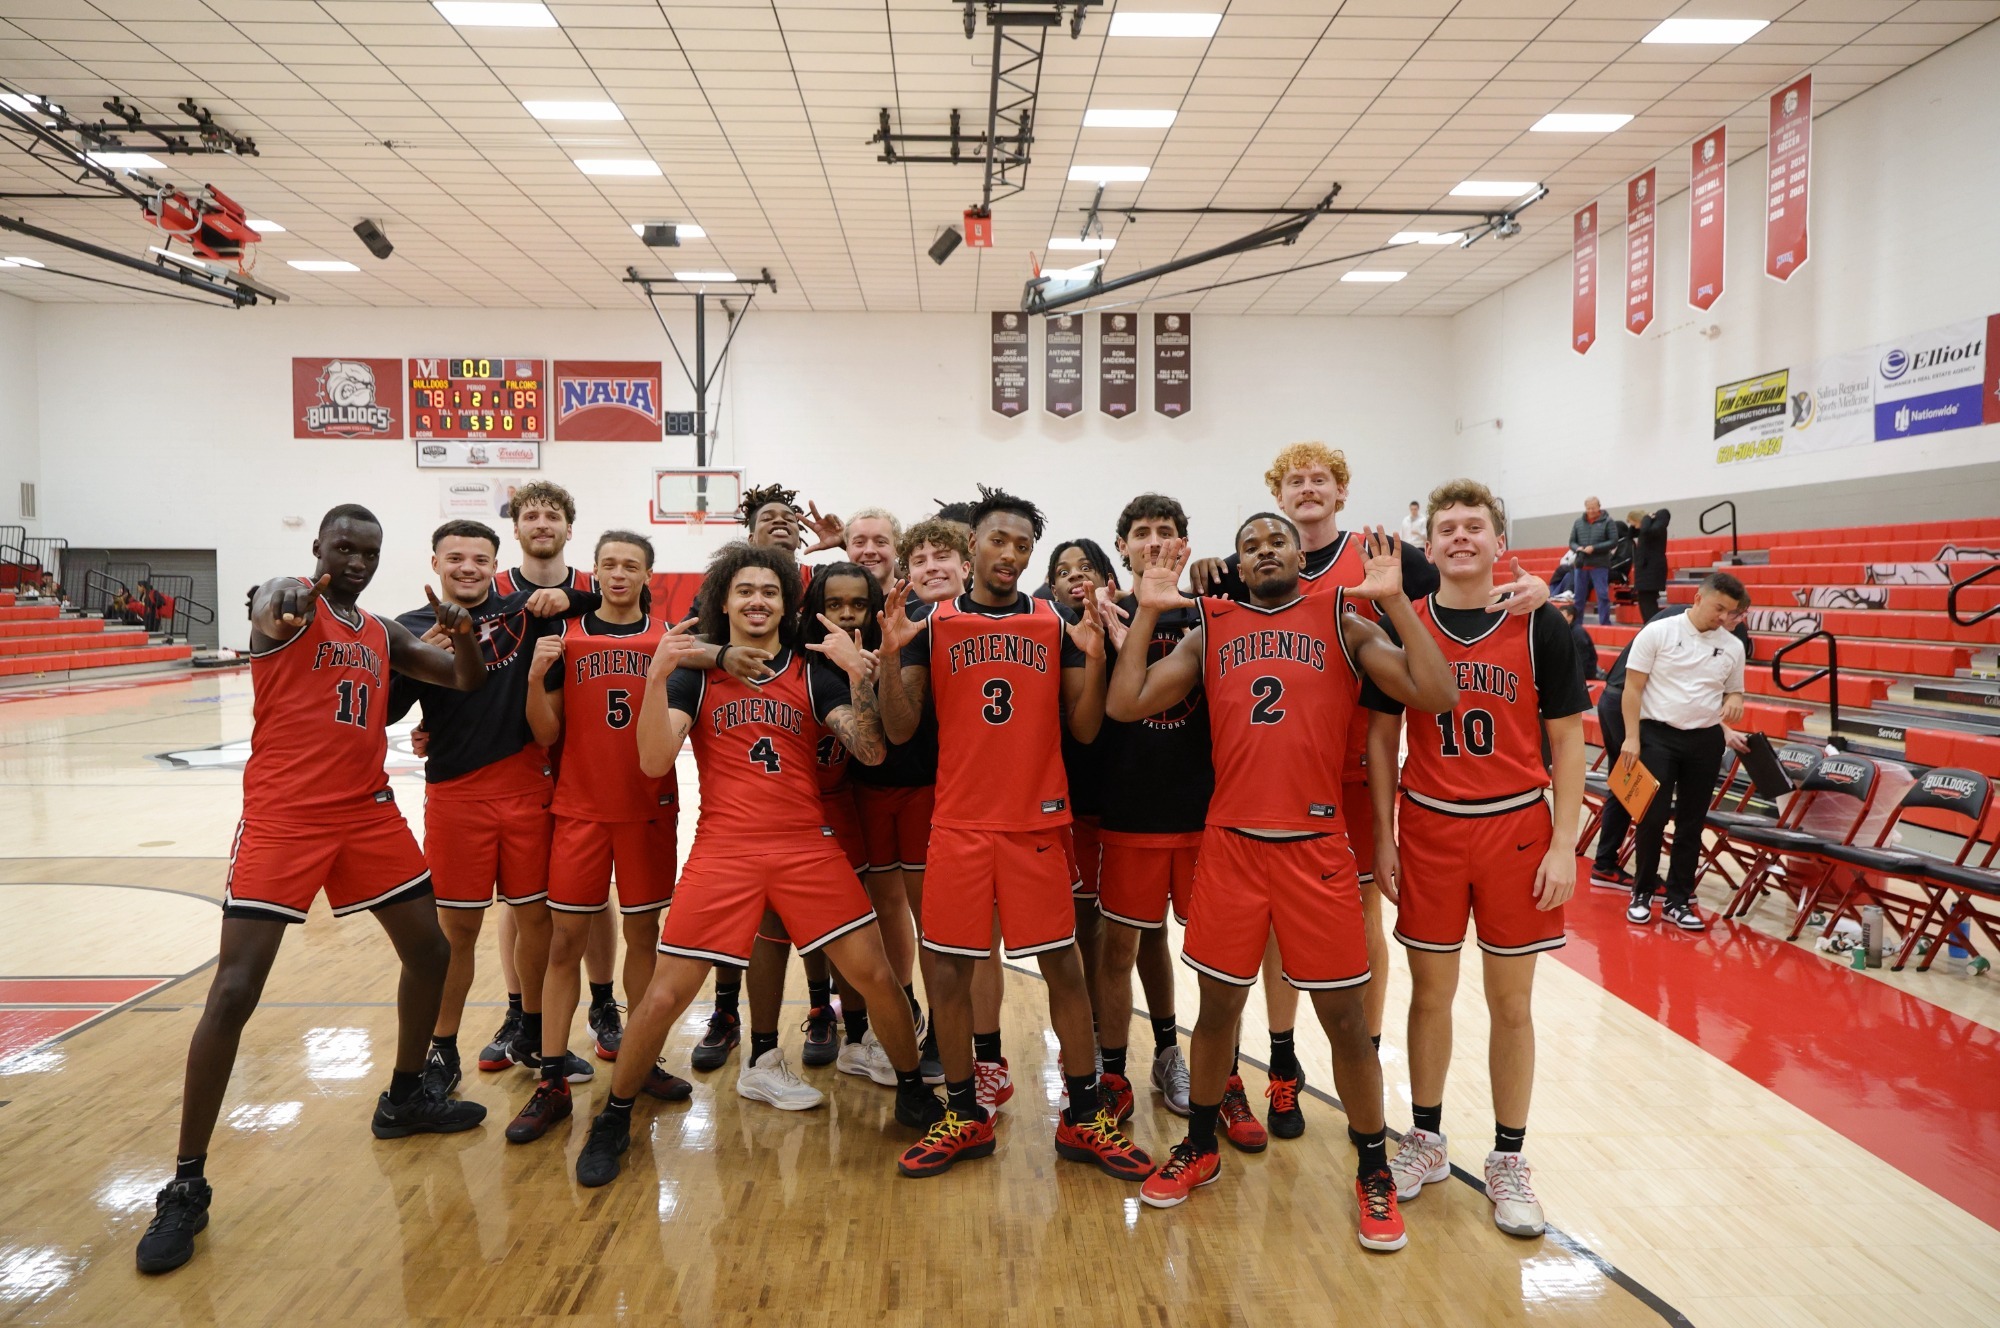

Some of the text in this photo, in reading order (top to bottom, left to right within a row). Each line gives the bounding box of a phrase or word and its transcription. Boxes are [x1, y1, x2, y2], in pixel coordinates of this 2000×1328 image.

[1777, 134, 1800, 154] SOCCER
[1912, 340, 1982, 370] Elliott
[416, 360, 490, 378] M 0.0
[1884, 380, 1912, 389] INSURANCE
[1952, 366, 1976, 375] AGENCY
[413, 380, 538, 390] BULLDOGS FALCONS
[1817, 376, 1869, 400] Salina Regional
[424, 390, 536, 409] 78 2 89
[562, 380, 654, 416] NAIA
[1718, 385, 1786, 413] TIM CHEATHAM
[1817, 396, 1870, 413] Sports Medicine
[309, 406, 388, 428] BULLDOGS
[422, 416, 431, 428] 9
[470, 416, 480, 430] 5
[485, 416, 494, 430] 3
[503, 416, 512, 430] 0
[527, 416, 536, 430] 8
[1720, 404, 1782, 424] CONSTRUCTION LLC
[1911, 404, 1958, 422] Nationwide
[497, 447, 534, 459] Freddy's
[486, 652, 518, 672] LCONS
[949, 634, 1047, 675] FRIENDS
[1218, 630, 1326, 679] FRIENDS
[576, 650, 653, 685] FRIEND
[1450, 662, 1518, 704] ENDS
[335, 680, 368, 730] 11
[606, 688, 633, 730] 5
[982, 678, 1014, 725] 3
[1250, 675, 1286, 724] 2
[712, 698, 804, 737] FRIENDS
[1142, 719, 1186, 730] FALCONS
[1436, 708, 1496, 757] 10
[1878, 728, 1902, 740] Service
[748, 736, 782, 774] 4
[1778, 750, 1814, 768] BULLDOGS
[1820, 762, 1864, 780] BULLDOGS
[1924, 776, 1976, 796] BULLDOGS
